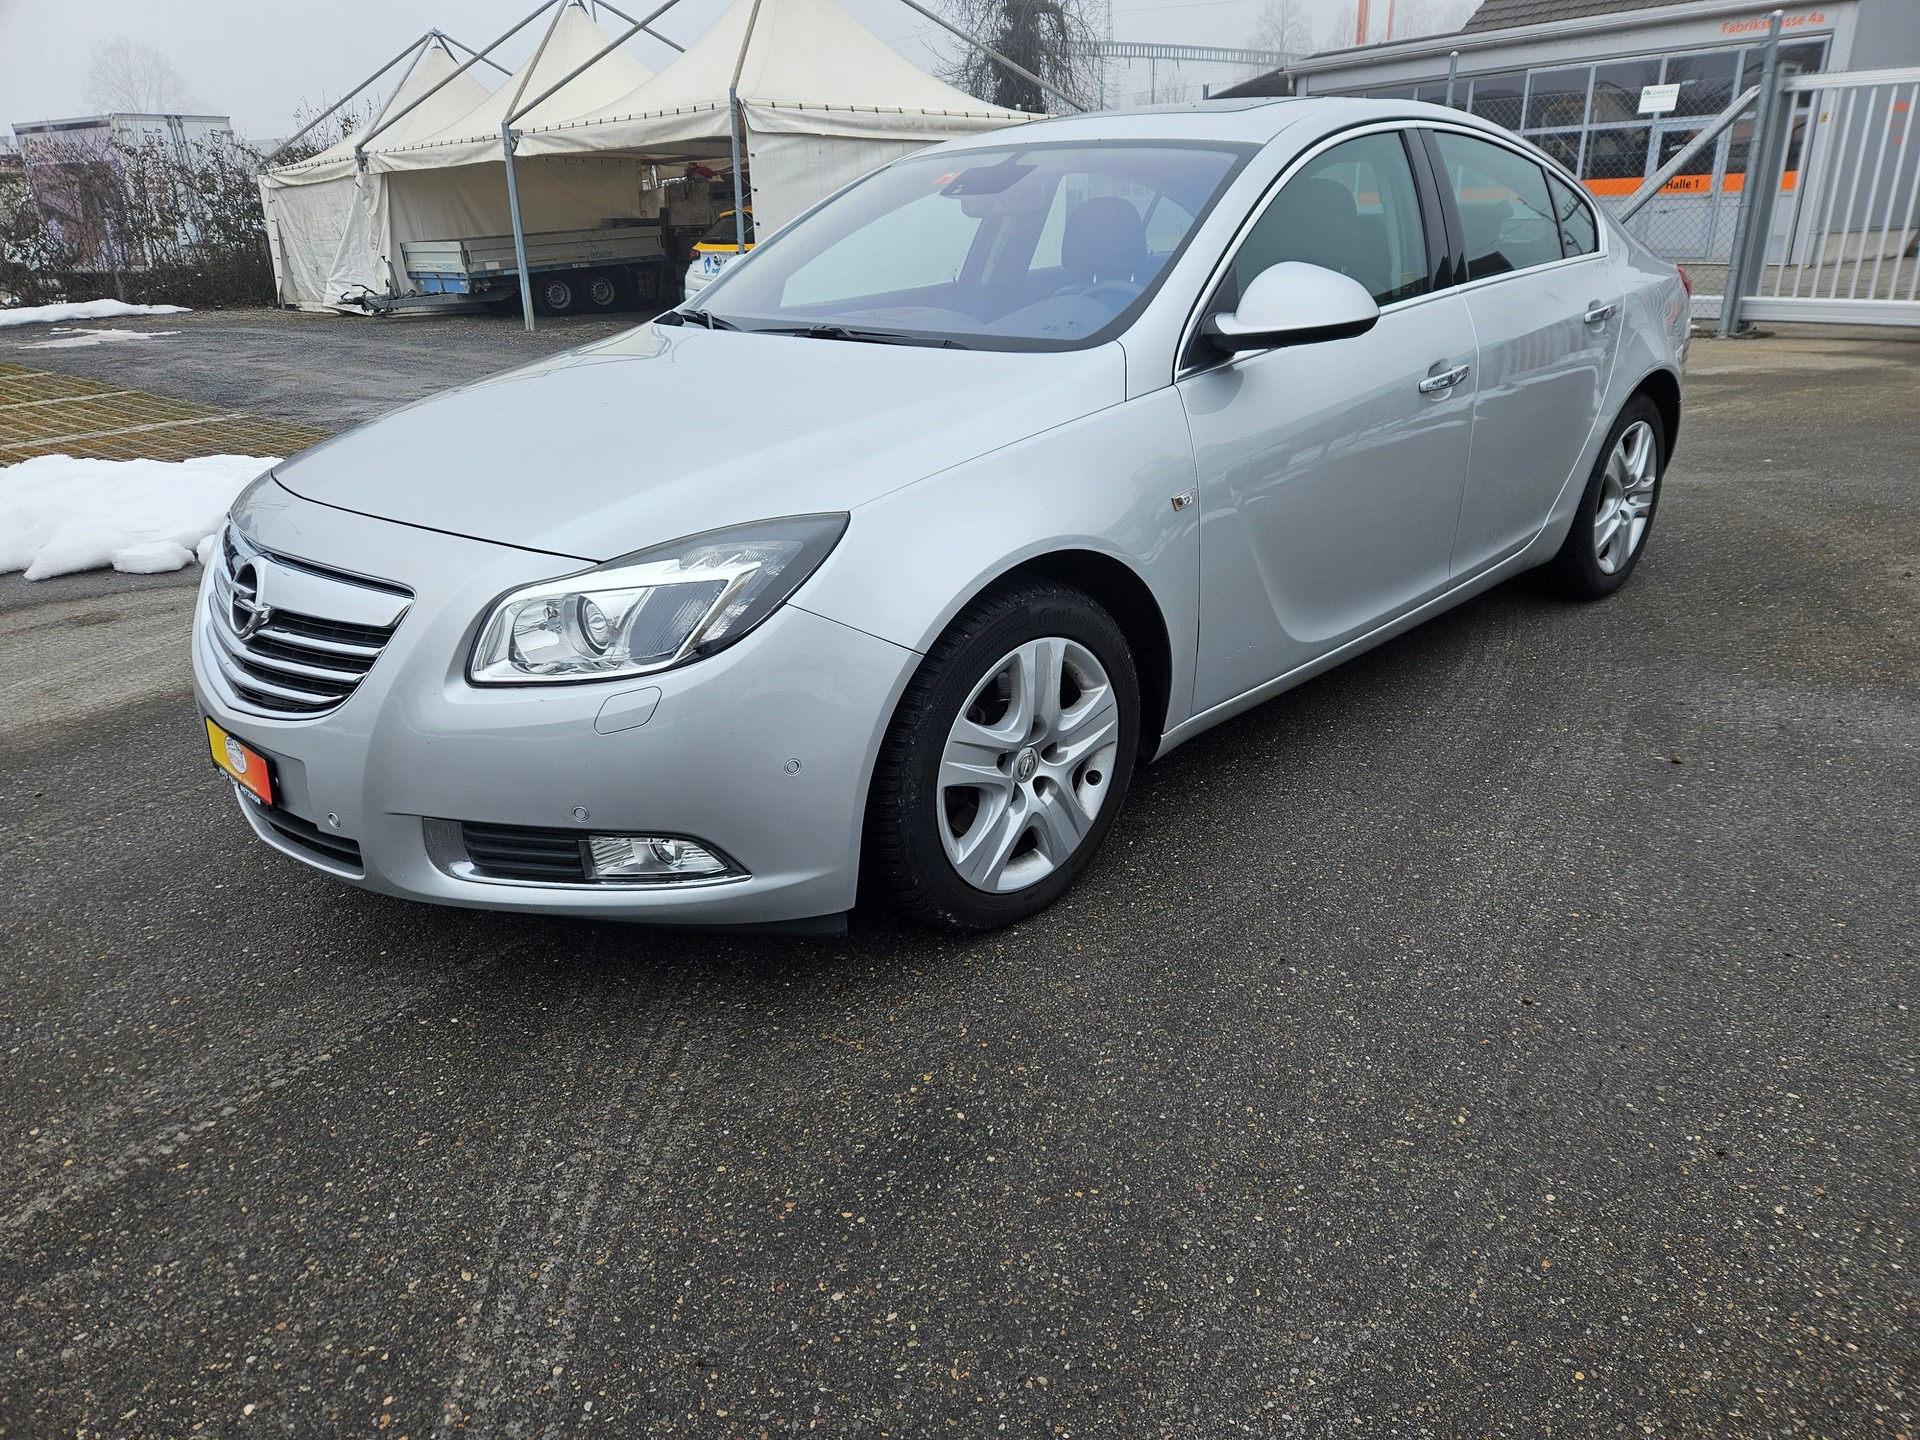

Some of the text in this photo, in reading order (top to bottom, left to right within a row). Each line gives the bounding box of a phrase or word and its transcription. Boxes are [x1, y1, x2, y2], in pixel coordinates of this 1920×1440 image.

[1721, 12, 1825, 33] Fabrikstasse 4a
[1665, 179, 1699, 189] Halle 1
